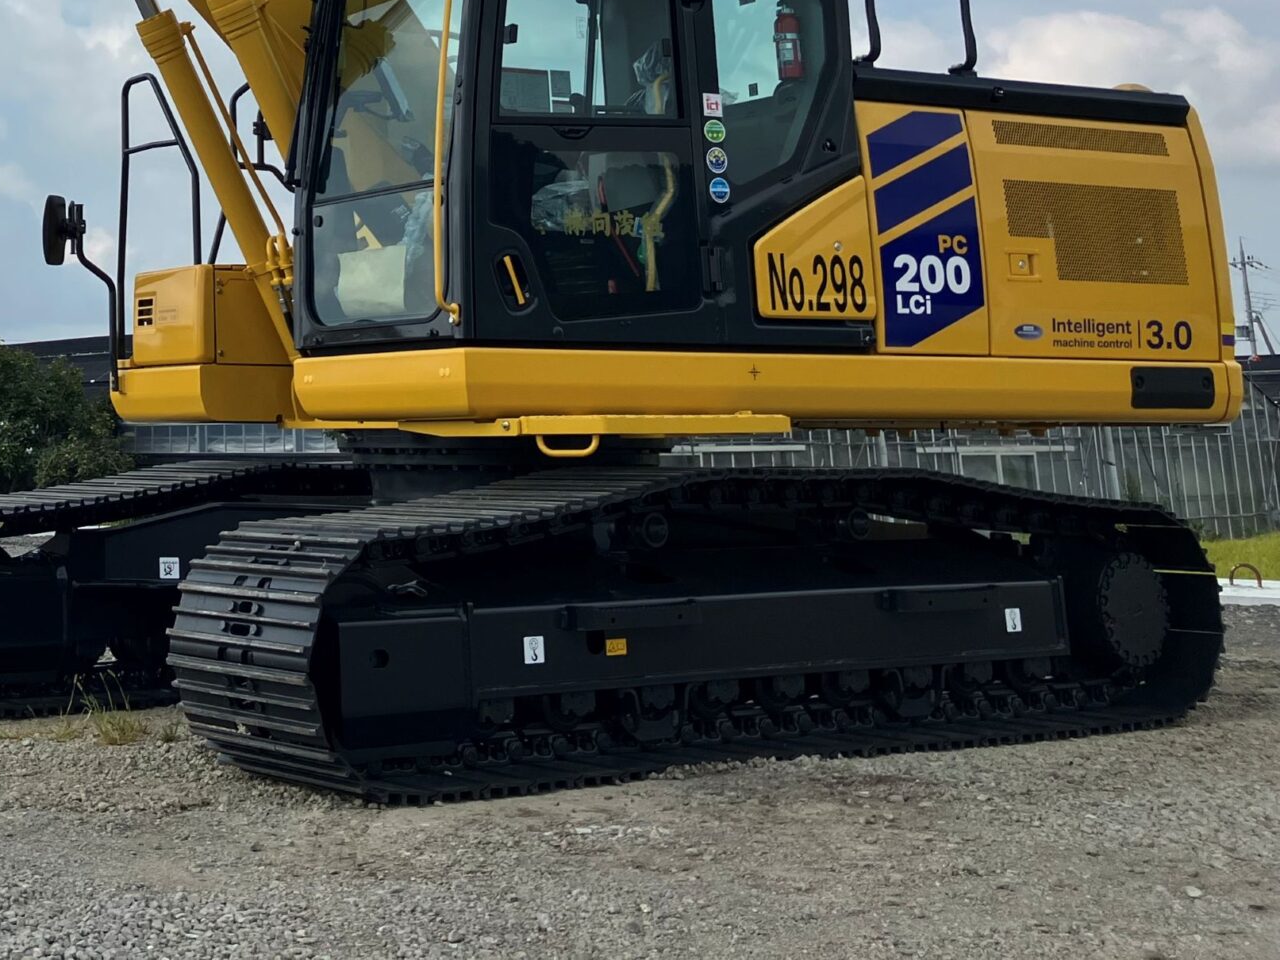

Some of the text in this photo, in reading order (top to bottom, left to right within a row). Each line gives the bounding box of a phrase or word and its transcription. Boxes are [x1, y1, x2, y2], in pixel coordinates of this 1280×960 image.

[937, 234, 968, 254] PC
[767, 252, 867, 313] No.298
[893, 253, 971, 294] 200
[896, 294, 932, 315] LCi
[1051, 318, 1132, 337] Intelligent
[1145, 320, 1193, 350] 3.0
[1052, 338, 1133, 349] machine control
